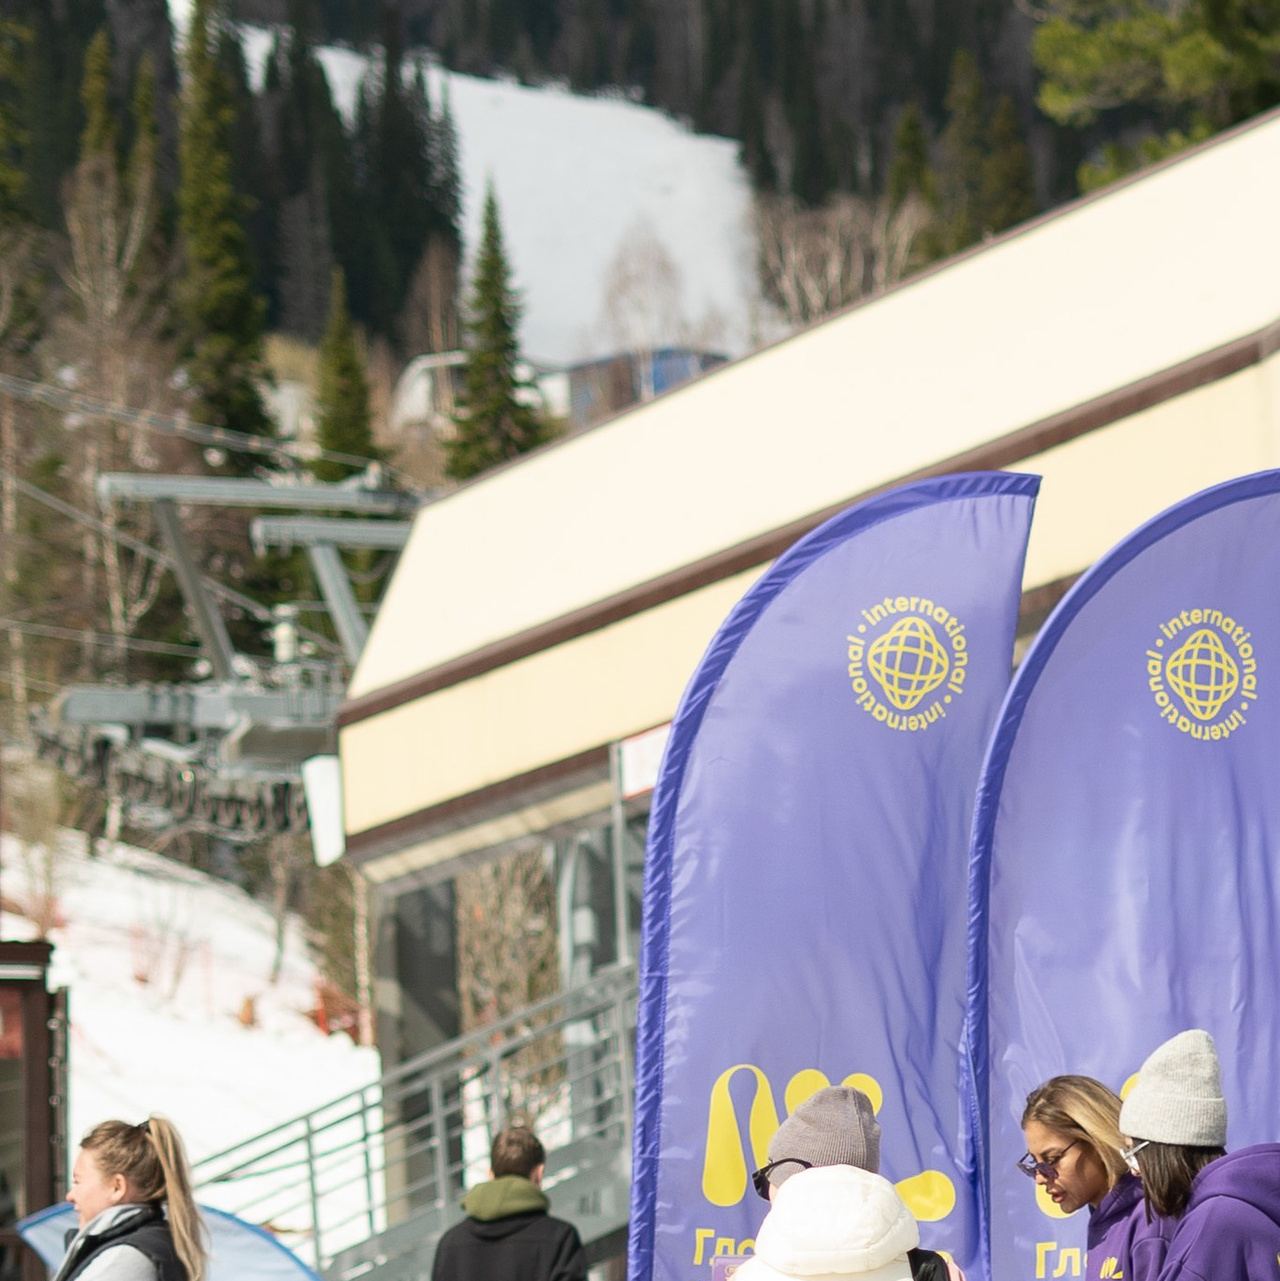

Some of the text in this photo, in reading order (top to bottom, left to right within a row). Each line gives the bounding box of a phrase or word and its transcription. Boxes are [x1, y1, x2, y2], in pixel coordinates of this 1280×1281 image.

[846, 634, 946, 731] international
[860, 596, 968, 694] international
[1159, 608, 1258, 700] international
[1146, 649, 1246, 740] international
